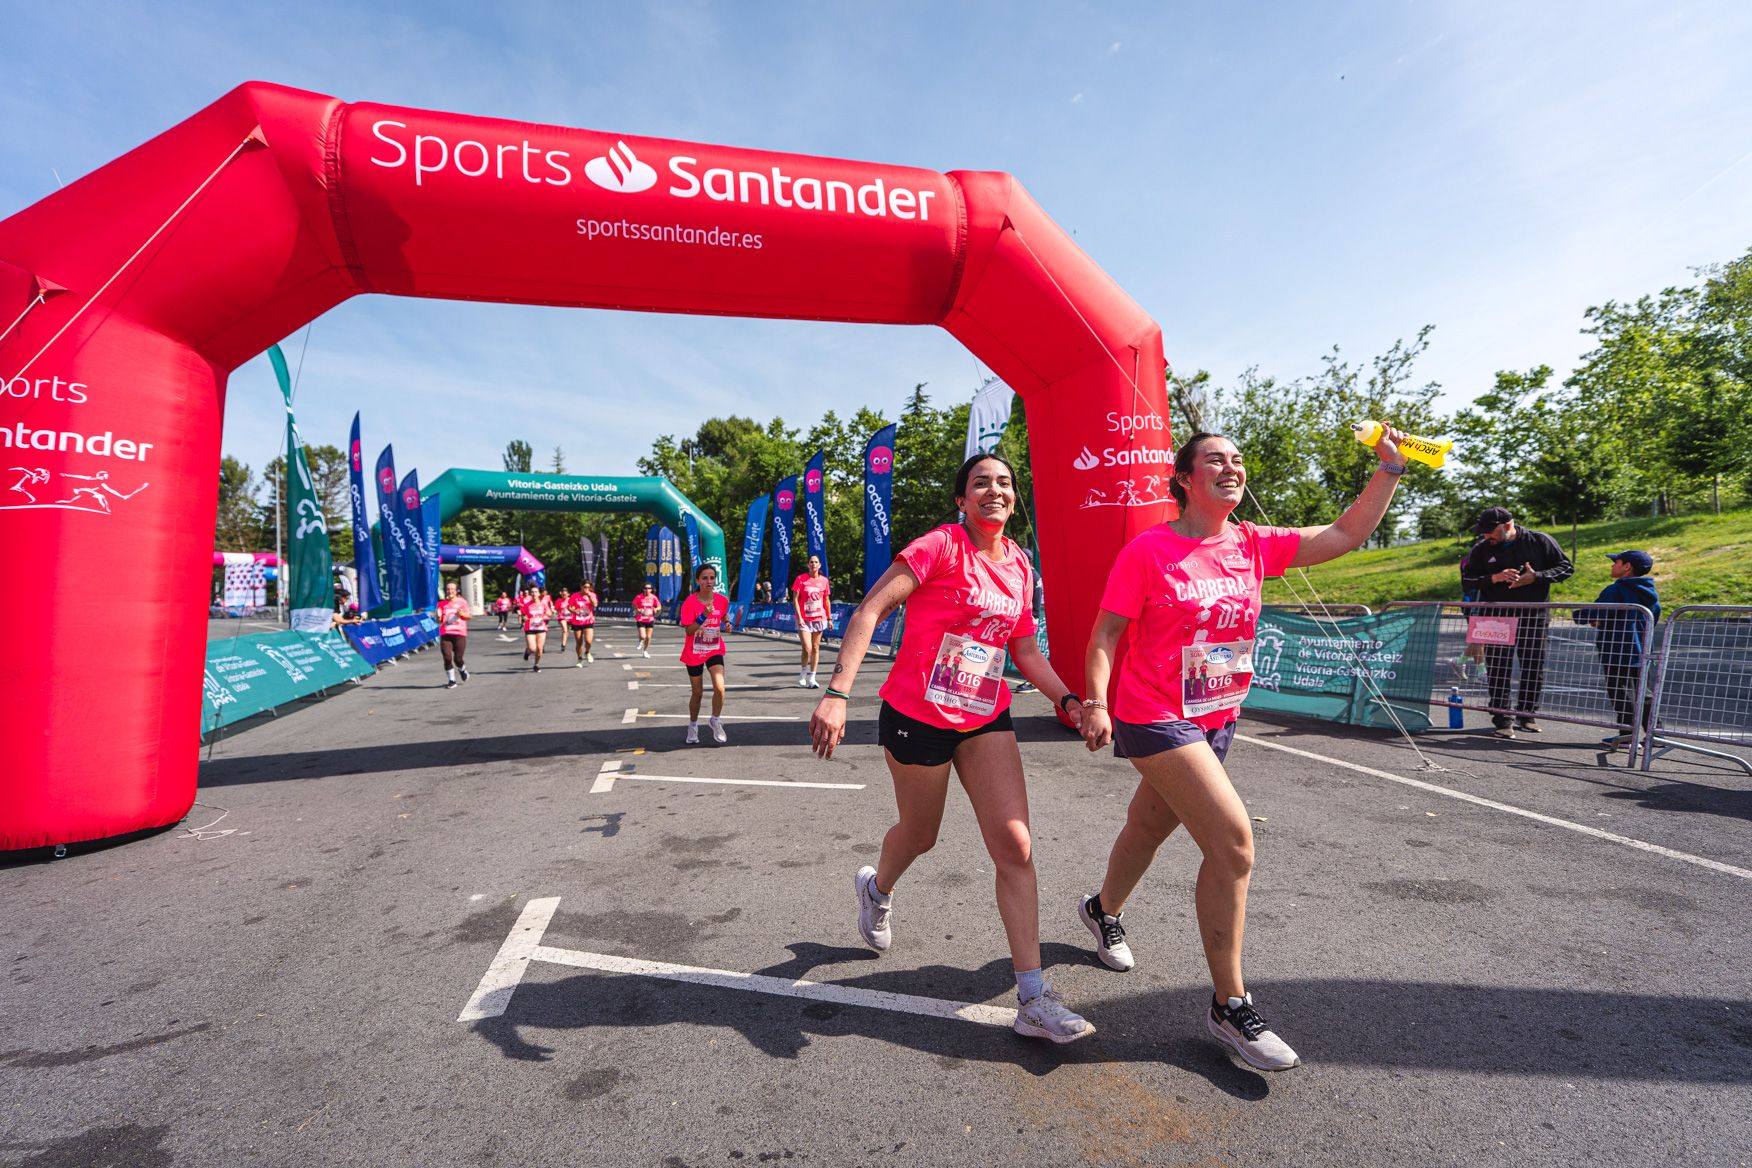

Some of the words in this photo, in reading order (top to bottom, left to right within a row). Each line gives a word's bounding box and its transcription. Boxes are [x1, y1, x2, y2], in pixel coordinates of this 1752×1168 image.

[370, 120, 572, 186] Sports
[668, 156, 935, 221] Santander
[576, 216, 763, 250] sportssantander.es
[1106, 411, 1163, 436] Sports
[507, 479, 589, 491] Vitoria-Gasteizko
[591, 483, 618, 492] Udala
[486, 489, 555, 501] Ayuntamiento
[557, 492, 569, 501] de
[571, 493, 638, 503] Vitoria-Gasteiz
[867, 484, 889, 536] octopus
[774, 516, 791, 555] octopus
[870, 519, 883, 544] energy
[744, 522, 761, 563] Marlene
[1166, 561, 1198, 572] OYSHO
[1176, 577, 1248, 602] CARRERA
[967, 587, 1022, 619] CARRERA
[1216, 604, 1241, 629] DE
[1299, 636, 1383, 650] Ayuntamiento
[1475, 631, 1508, 639] EVENTOS
[1298, 648, 1312, 658] de
[1314, 649, 1404, 663] Vitoria-Gasteiz
[1296, 662, 1397, 680] Vitoria-Gasteizko
[957, 672, 980, 687] 016
[1208, 674, 1233, 689] 016
[1293, 675, 1325, 687] Udala
[934, 693, 958, 704] OYSHO
[969, 703, 988, 711] Santander
